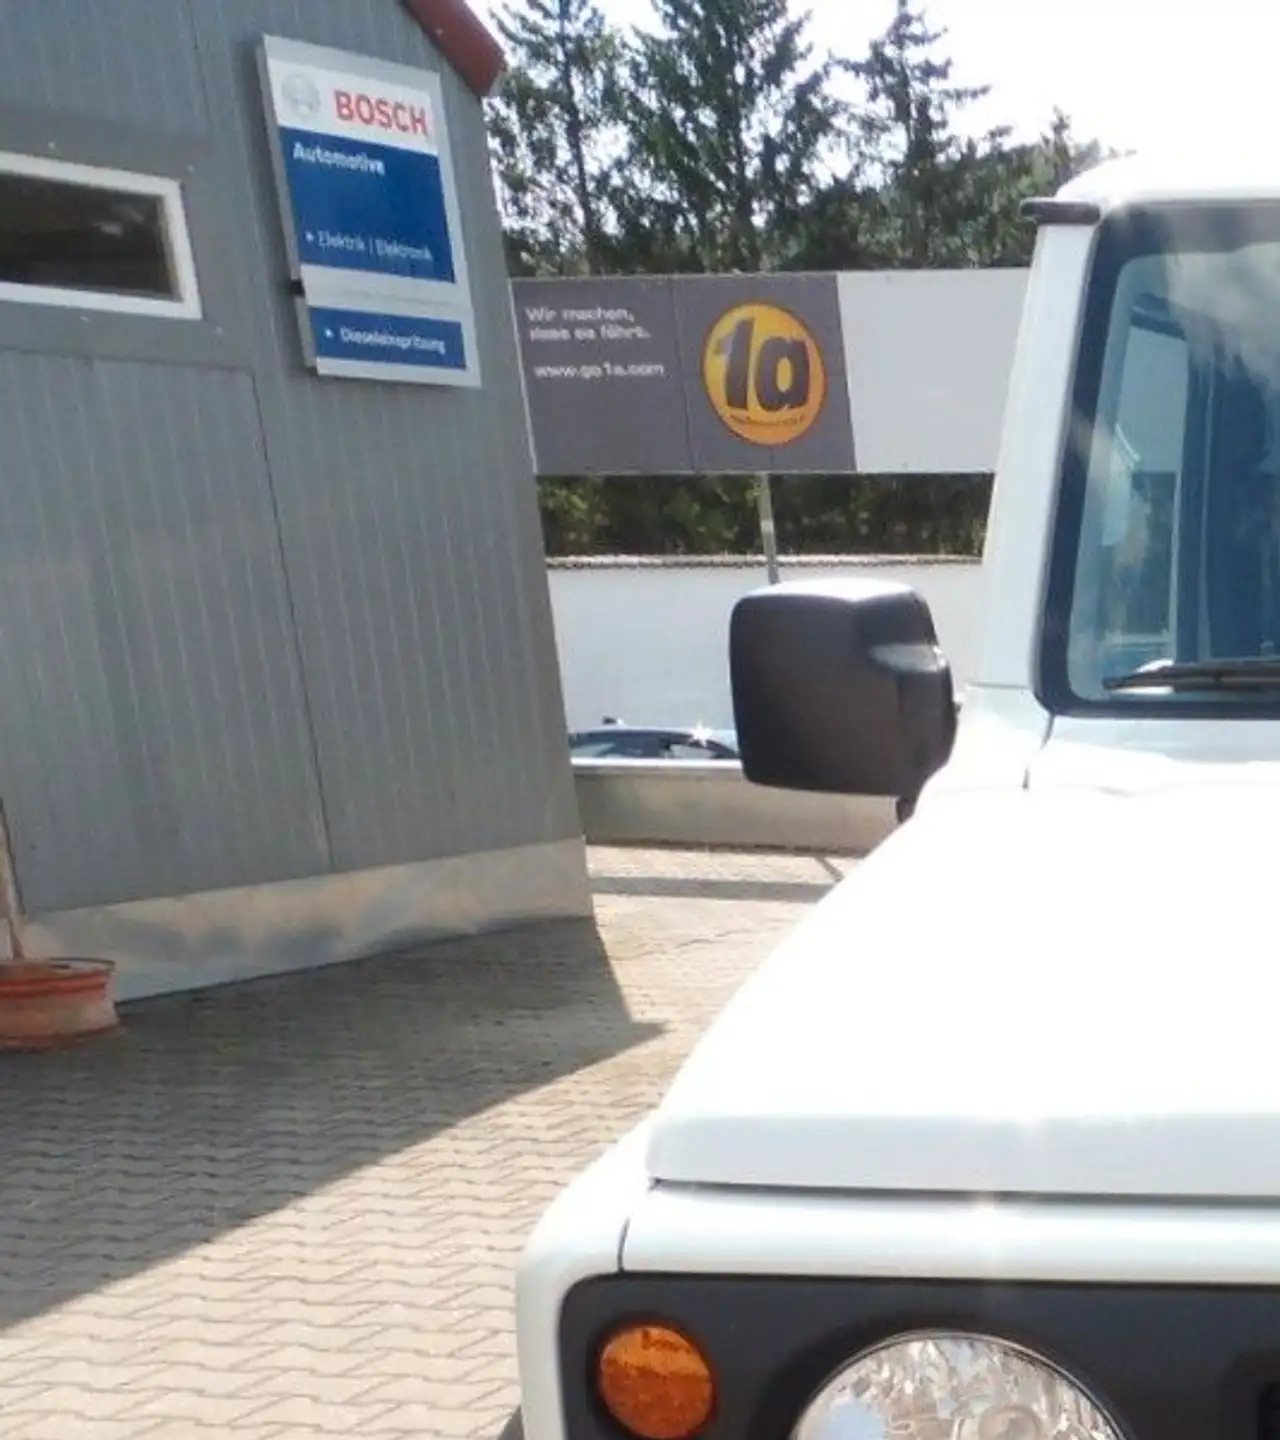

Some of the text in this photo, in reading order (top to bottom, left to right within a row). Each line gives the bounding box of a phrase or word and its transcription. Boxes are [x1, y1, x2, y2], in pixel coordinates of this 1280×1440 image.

[333, 89, 428, 135] BOSCH
[293, 141, 385, 175] Automotive
[525, 307, 556, 321] Wir
[714, 316, 811, 412] 1a
